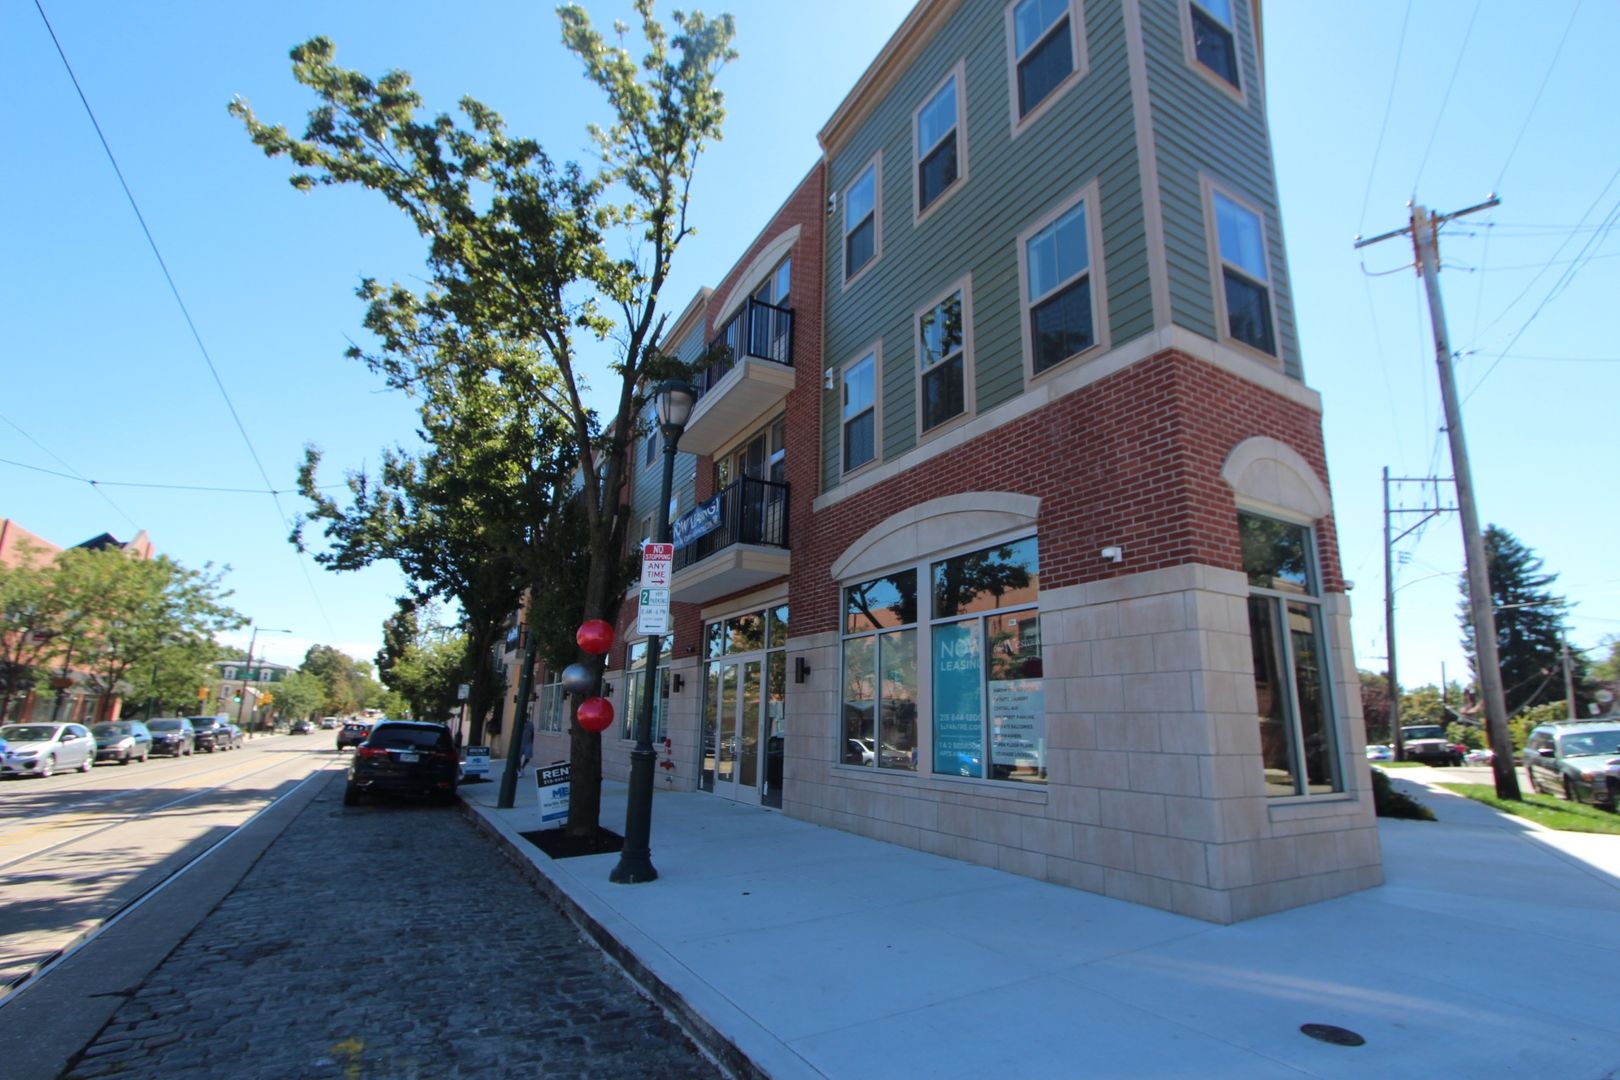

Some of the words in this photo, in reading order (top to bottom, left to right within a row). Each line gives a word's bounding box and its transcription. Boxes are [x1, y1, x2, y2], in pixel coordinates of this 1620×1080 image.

[653, 545, 663, 554] NO
[642, 591, 648, 603] 2
[542, 766, 571, 779] REN
